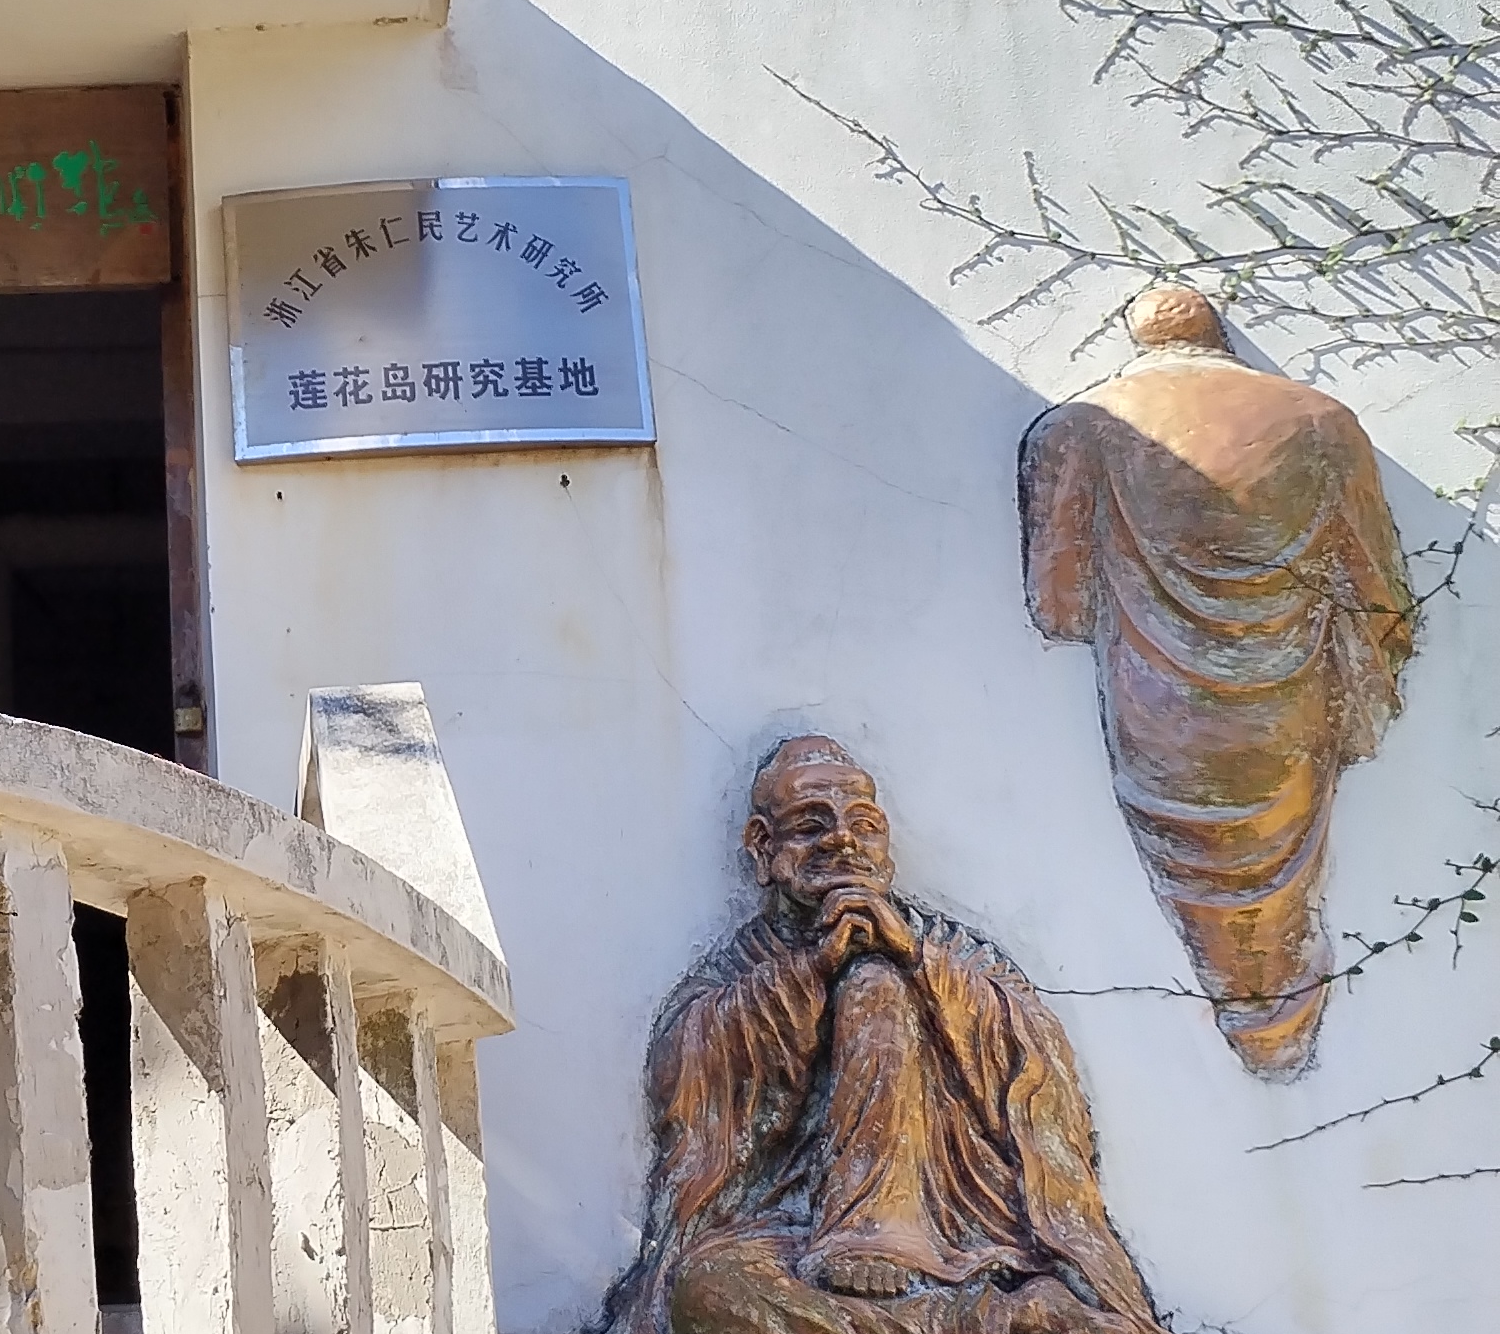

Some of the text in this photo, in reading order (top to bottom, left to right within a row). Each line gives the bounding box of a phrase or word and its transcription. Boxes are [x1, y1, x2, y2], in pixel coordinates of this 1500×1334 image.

[263, 210, 609, 328] 浙江省朱仁民艺术研究所
[287, 357, 599, 411] 莲花岛研究基地
